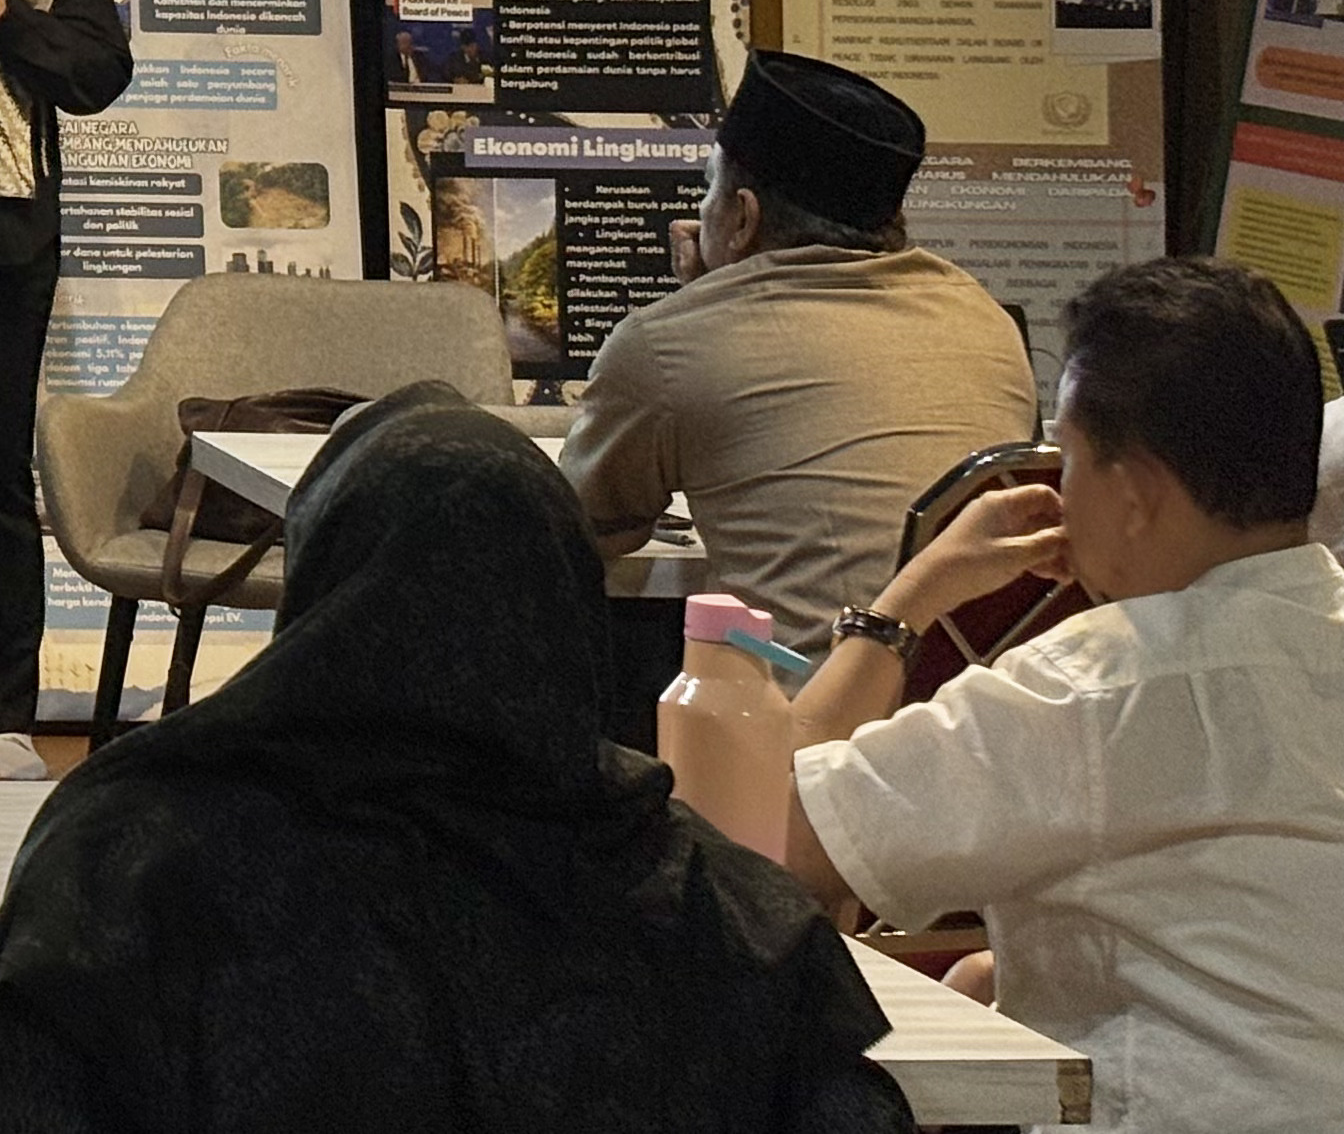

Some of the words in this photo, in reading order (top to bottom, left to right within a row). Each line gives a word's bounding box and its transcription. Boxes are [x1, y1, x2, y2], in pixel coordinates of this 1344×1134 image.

[207, 10, 256, 21] Indonesia
[509, 22, 566, 31] Berpotensi
[619, 22, 670, 31] Indonesia
[536, 66, 600, 75] perdamaian
[500, 79, 558, 90] bergabung
[80, 122, 138, 135] NEGARA
[115, 138, 229, 154] MENDAHULUKAN
[473, 137, 578, 158] Ekonomi
[583, 139, 718, 162] Lingkunga
[132, 154, 192, 168] EKONOMI
[1012, 157, 1133, 167] BERKEMBANG
[89, 176, 148, 187] kemiskinan
[150, 178, 185, 189] rakyat
[992, 171, 1132, 182] MENDAHULUKAN
[950, 186, 1026, 196] EKONOMI
[116, 206, 162, 217] stabilitas
[165, 208, 194, 217] sosial
[83, 219, 103, 230] dan
[106, 220, 139, 232] politik
[602, 214, 644, 226] panjang
[595, 229, 656, 241] Lingkungan
[103, 248, 133, 258] untuk
[135, 248, 194, 260] pelestarian
[83, 261, 142, 274] lingkungan
